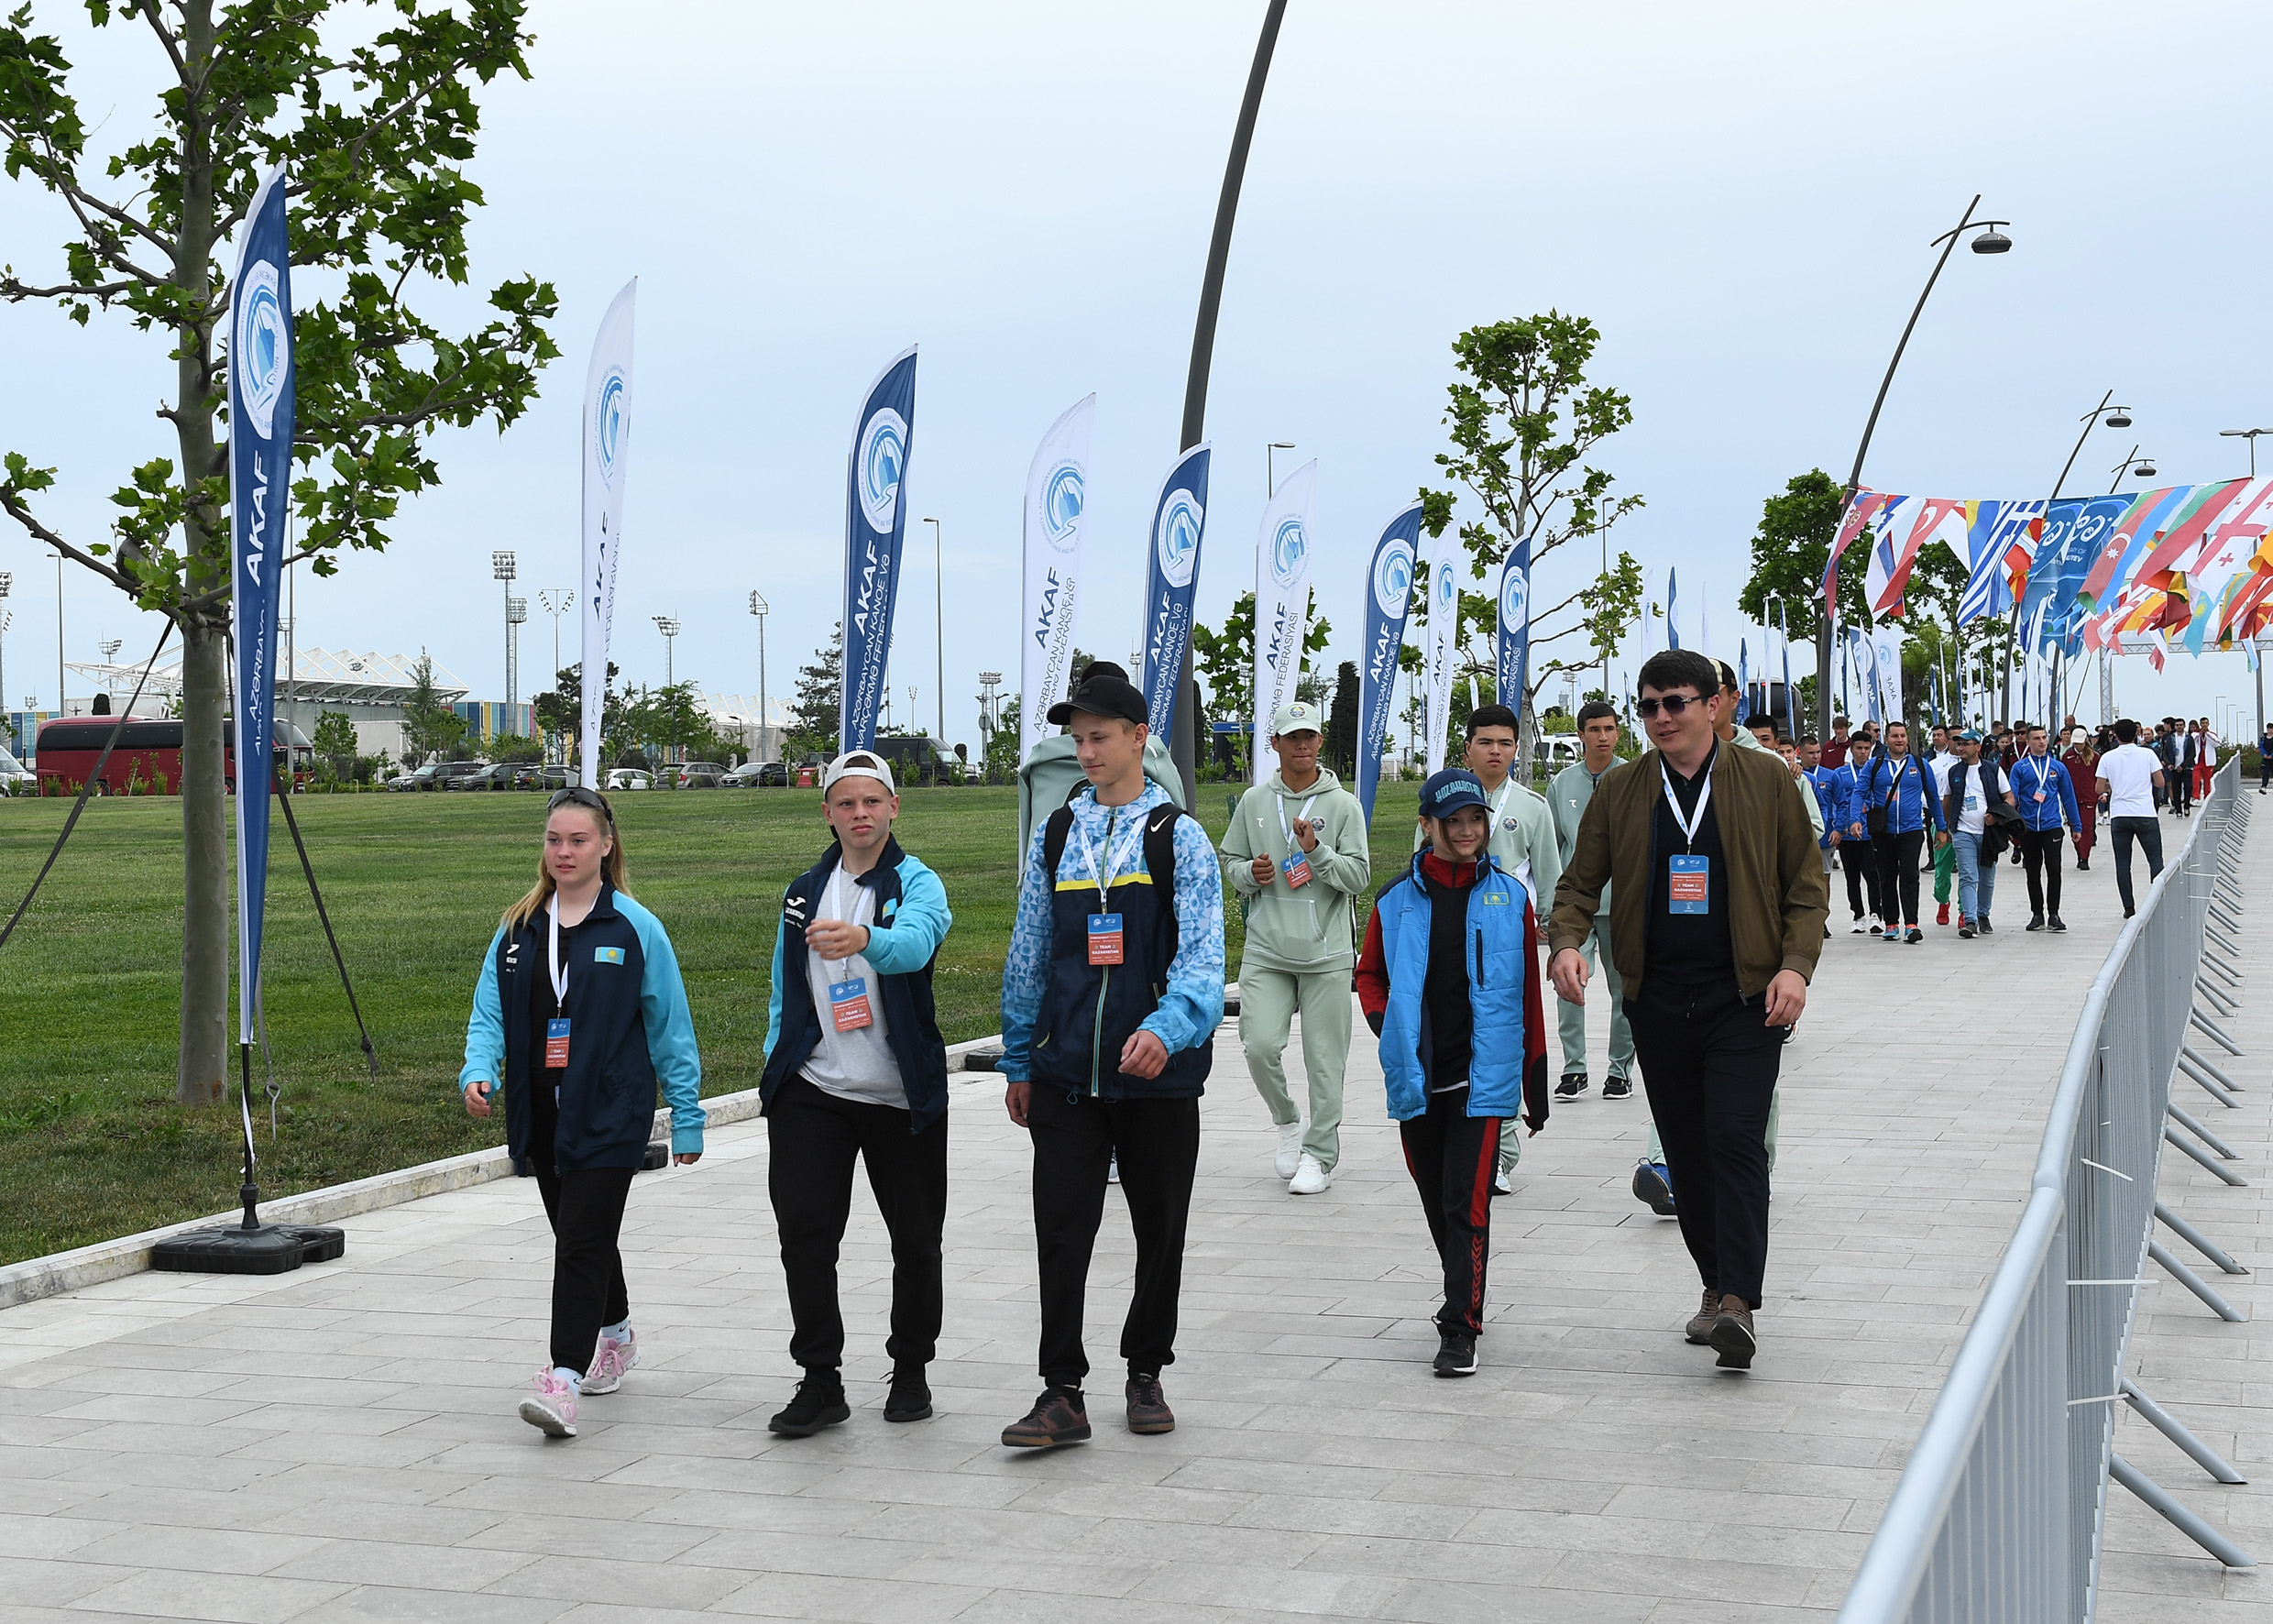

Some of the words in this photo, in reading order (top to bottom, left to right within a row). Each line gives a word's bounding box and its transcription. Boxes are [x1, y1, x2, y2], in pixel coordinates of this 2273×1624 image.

[246, 450, 269, 587] AKAF
[854, 540, 878, 637] AKAF
[1035, 566, 1060, 650] AKAF
[1150, 591, 1170, 667] AKAF
[851, 632, 875, 730] AZƏRBAYCAN
[870, 578, 885, 631] KANOE
[879, 554, 890, 575] VƏ
[1034, 645, 1060, 731] AZƏRBAYCAN
[1054, 598, 1068, 643] KANOE
[1147, 663, 1169, 735] ZƏRBAYCAN
[1162, 621, 1180, 664] KANOE
[1171, 602, 1183, 620] VƏ
[1266, 601, 1286, 670] AKAF
[1276, 612, 1299, 686] FEDERASİYASI
[1369, 621, 1390, 684] AKAF
[1433, 630, 1445, 686] AKAF
[1500, 636, 1512, 689] AKAF
[1367, 681, 1389, 744] AZƏRBAYCAN
[1384, 644, 1398, 682] KANOE
[1391, 631, 1400, 646] VƏ
